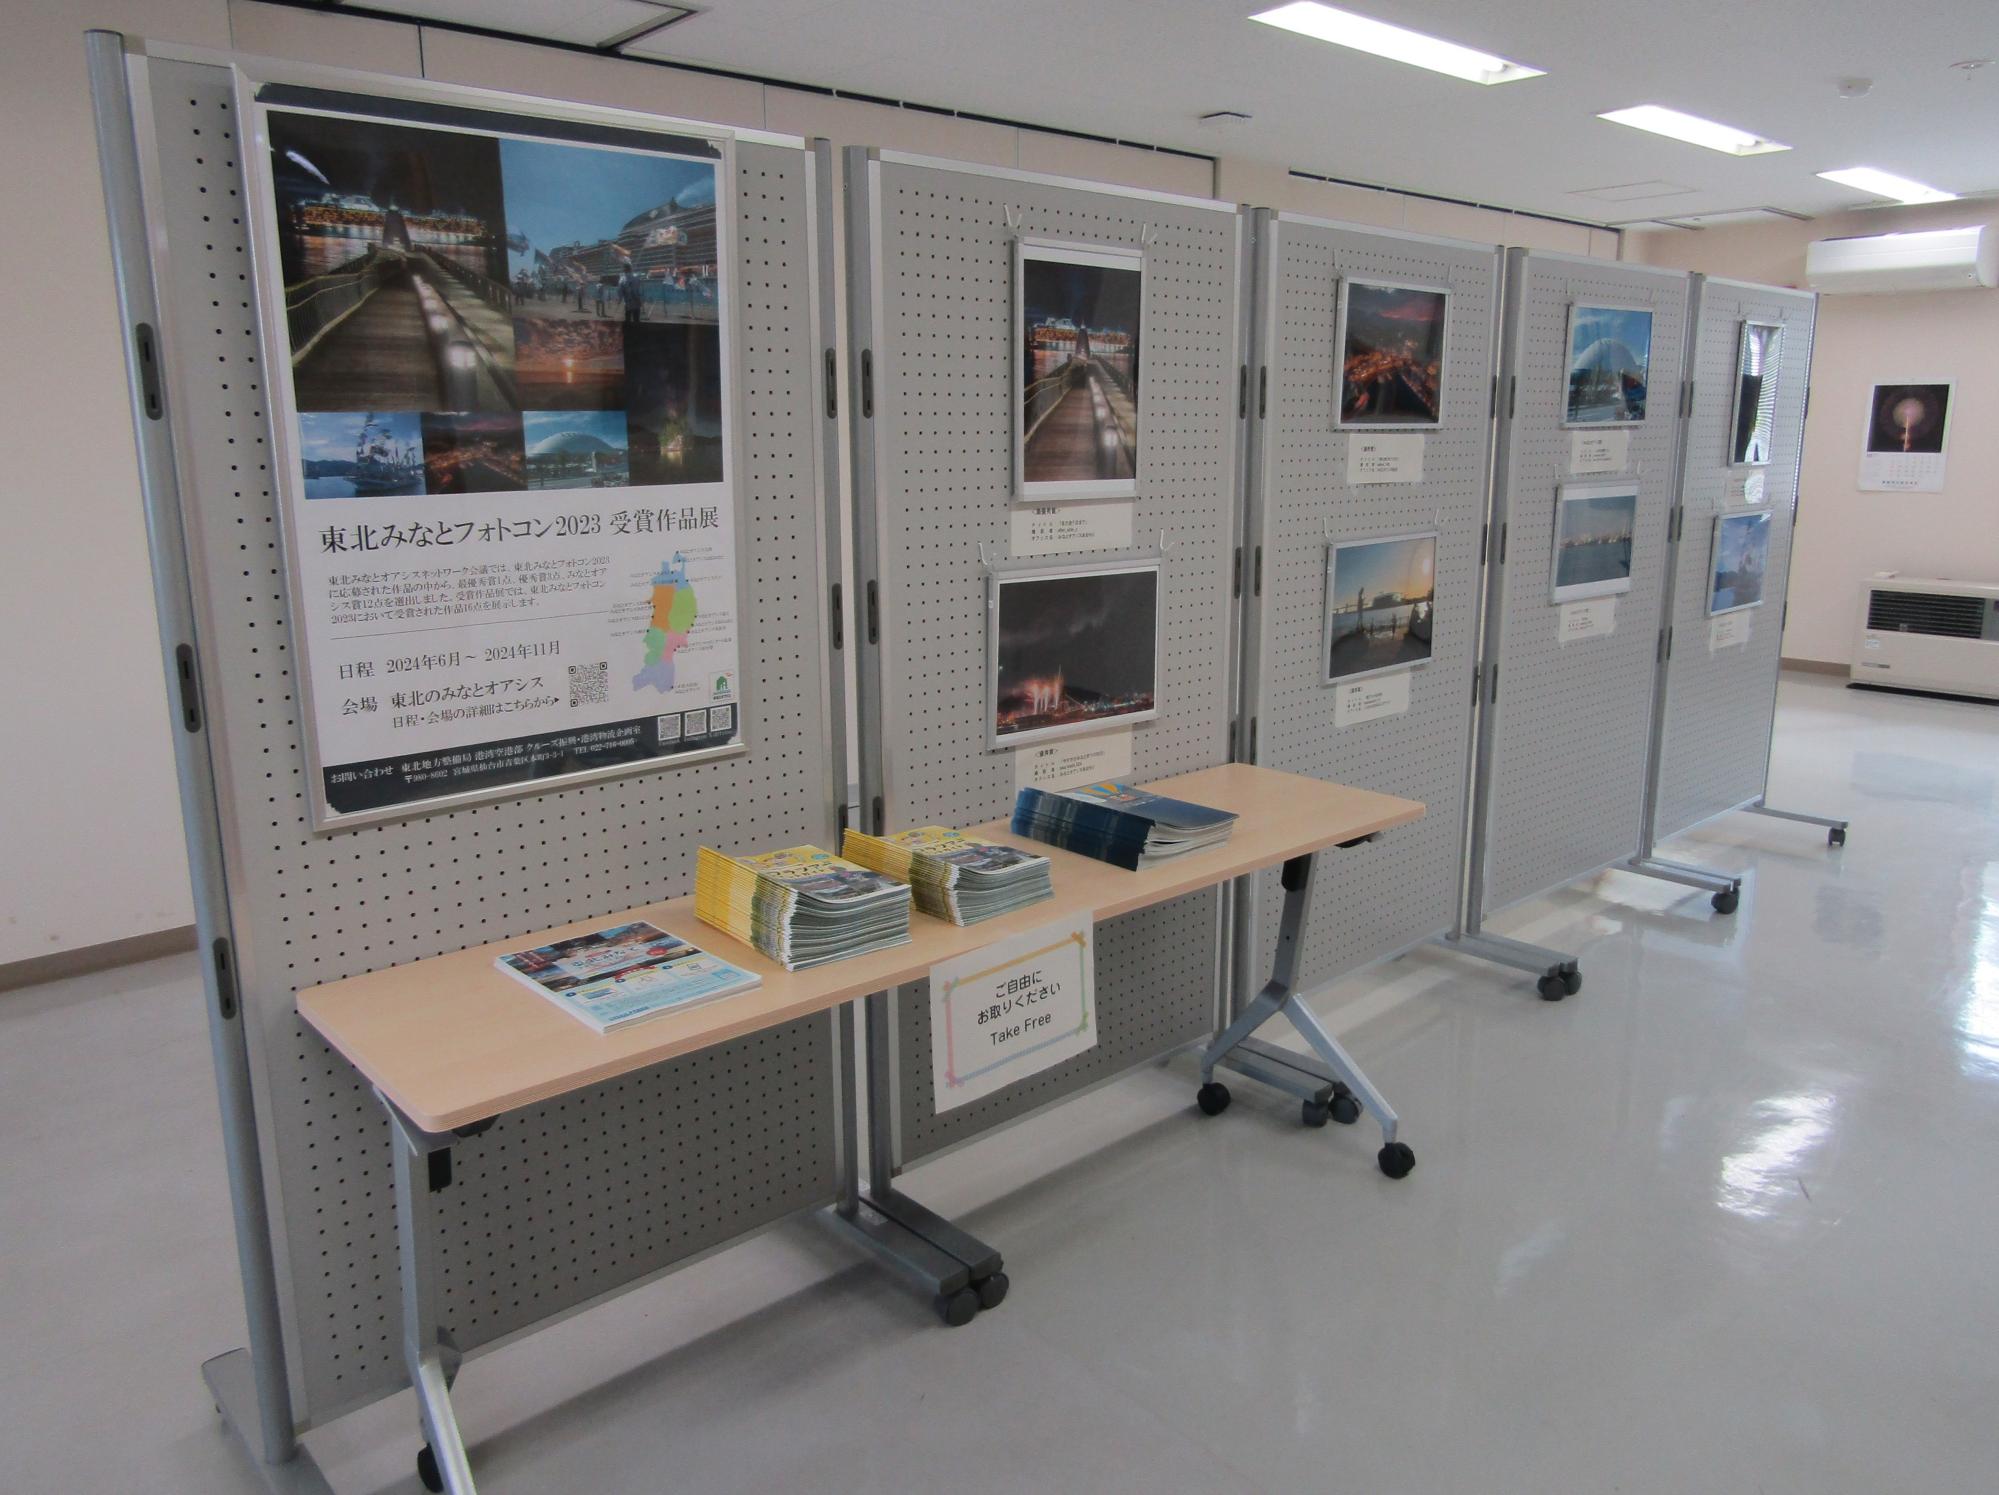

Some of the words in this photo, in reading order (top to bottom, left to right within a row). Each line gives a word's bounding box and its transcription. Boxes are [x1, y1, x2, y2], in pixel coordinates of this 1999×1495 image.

[319, 514, 601, 553] 東北みなとフォトコン2023
[609, 506, 719, 536] 受賞作品展
[339, 661, 375, 680] 日程
[484, 639, 561, 662] 2024年11月
[342, 696, 378, 716] 会場
[391, 676, 544, 709] 東北のみなとオアシス
[330, 765, 394, 785] お問い合わせ
[977, 982, 1061, 1025] お取りください
[996, 969, 1043, 999] ご自由に
[990, 1023, 1020, 1046] Take
[1024, 1012, 1052, 1033] Free
